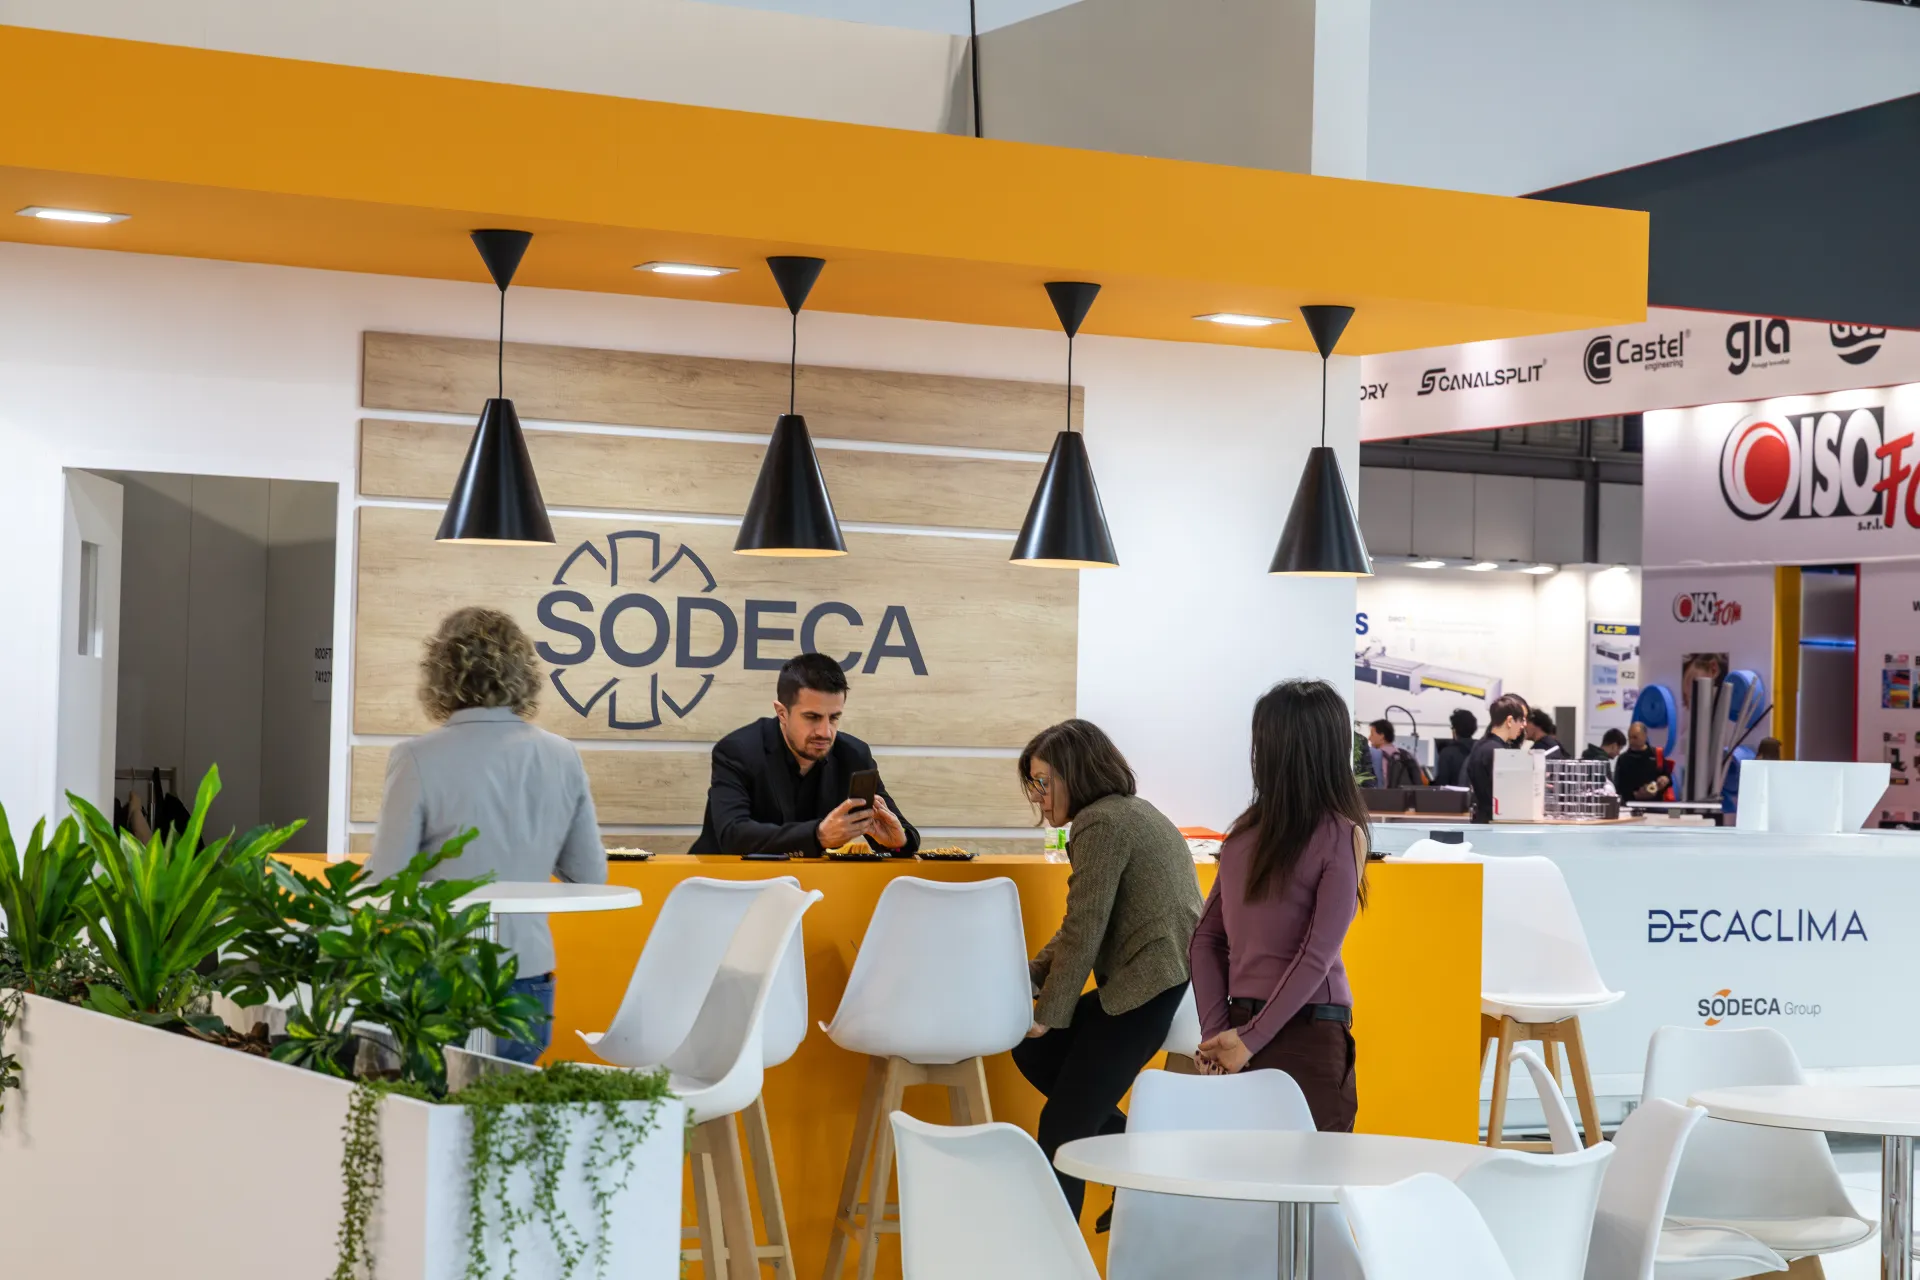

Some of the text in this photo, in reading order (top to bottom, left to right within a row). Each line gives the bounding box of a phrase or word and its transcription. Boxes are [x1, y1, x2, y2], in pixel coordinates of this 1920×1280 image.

[1616, 331, 1684, 365] Castel
[1438, 363, 1543, 392] CANALSPLIT
[1644, 358, 1684, 372] engineering
[1857, 517, 1883, 531] s.r.l.
[535, 589, 929, 677] SODECA
[1647, 908, 1869, 943] DECACLIMA
[1697, 997, 1822, 1018] SODECA Group
